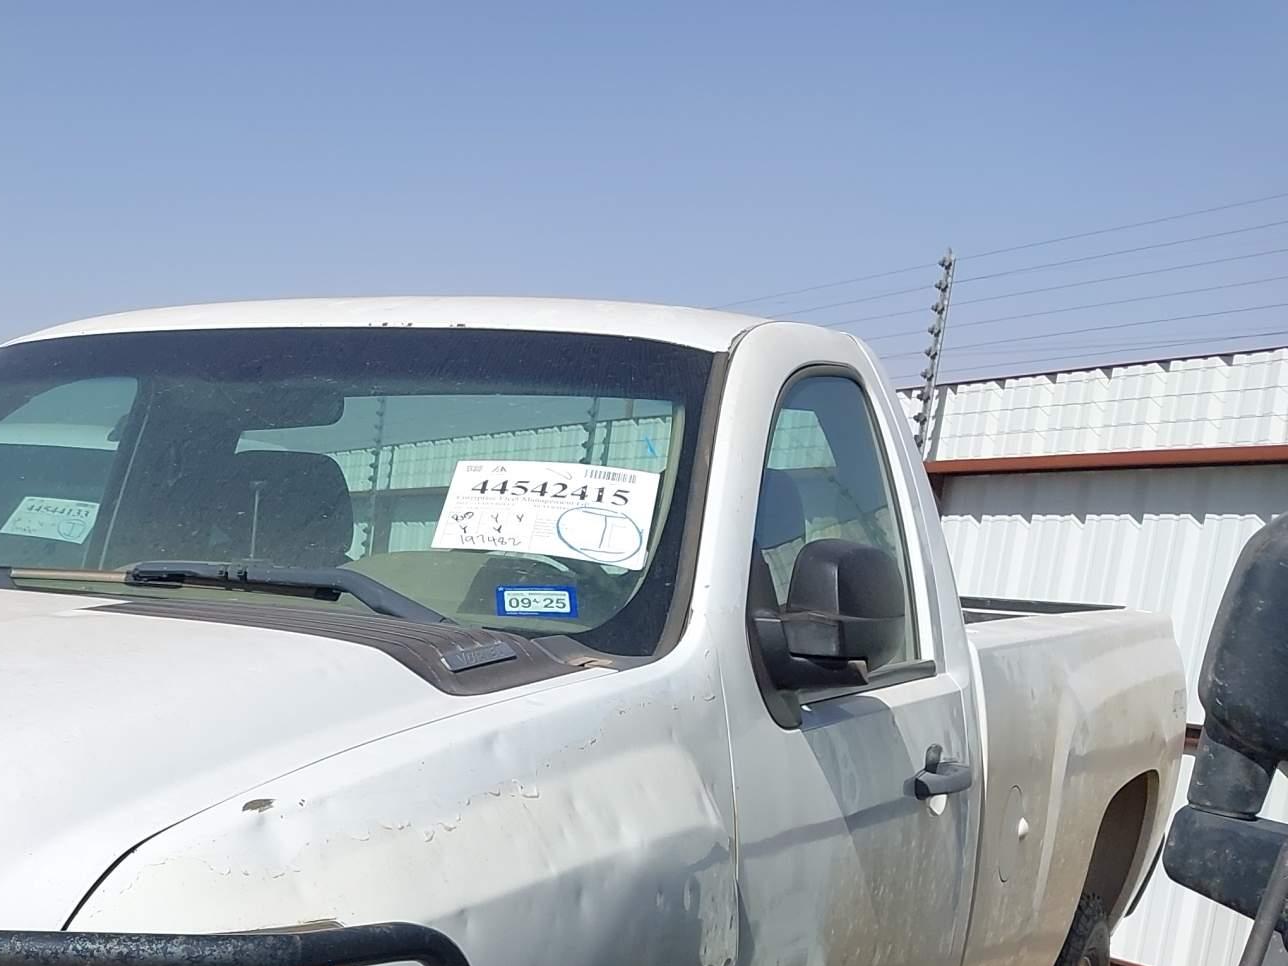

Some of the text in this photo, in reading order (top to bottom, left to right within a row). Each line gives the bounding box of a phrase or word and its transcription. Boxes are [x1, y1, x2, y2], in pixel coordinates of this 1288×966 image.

[471, 479, 631, 506] 44542415
[459, 533, 523, 547] 197482
[508, 597, 567, 609] 09 25
